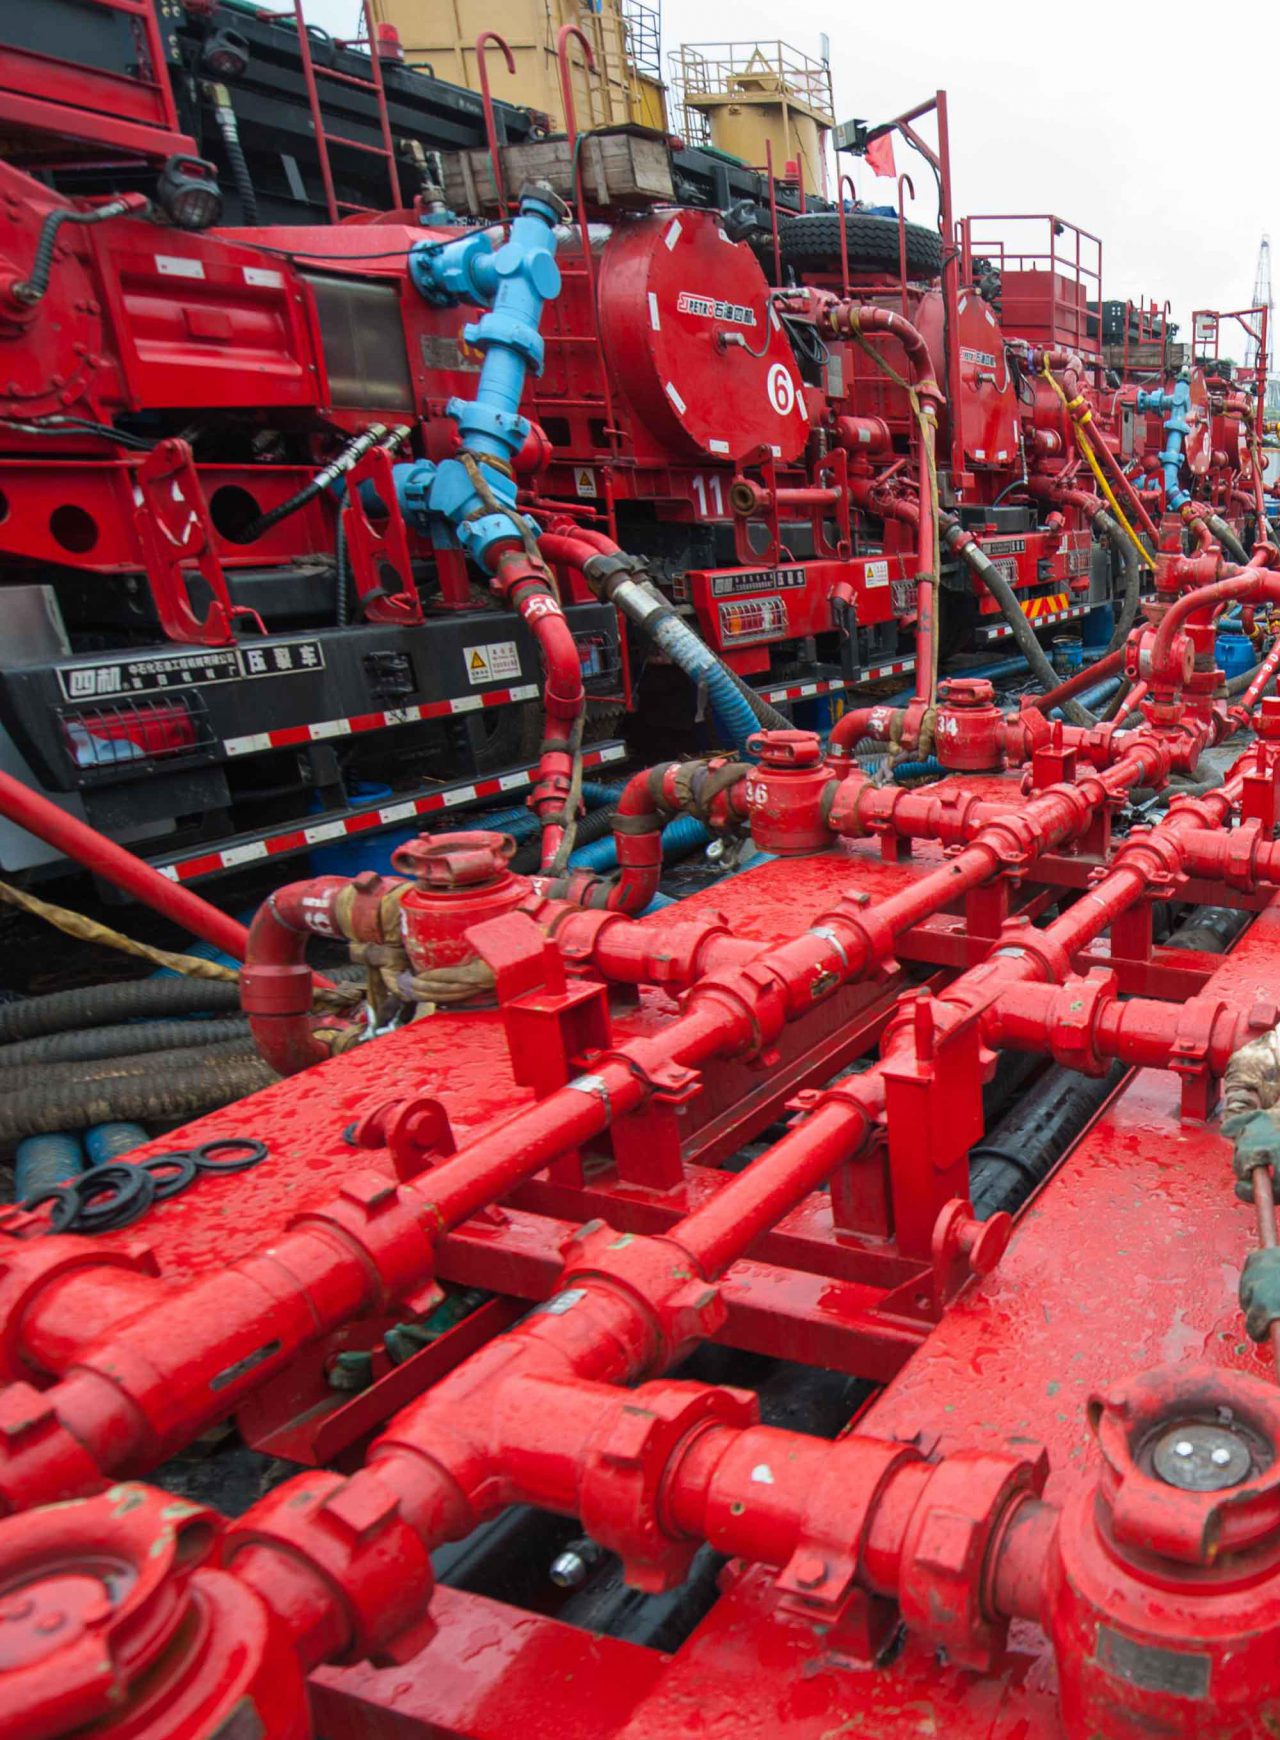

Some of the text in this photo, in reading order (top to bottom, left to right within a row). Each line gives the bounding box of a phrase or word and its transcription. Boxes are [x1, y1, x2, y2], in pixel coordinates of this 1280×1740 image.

[692, 475, 724, 516] 11
[69, 666, 121, 697] 四机
[937, 715, 958, 737] 34
